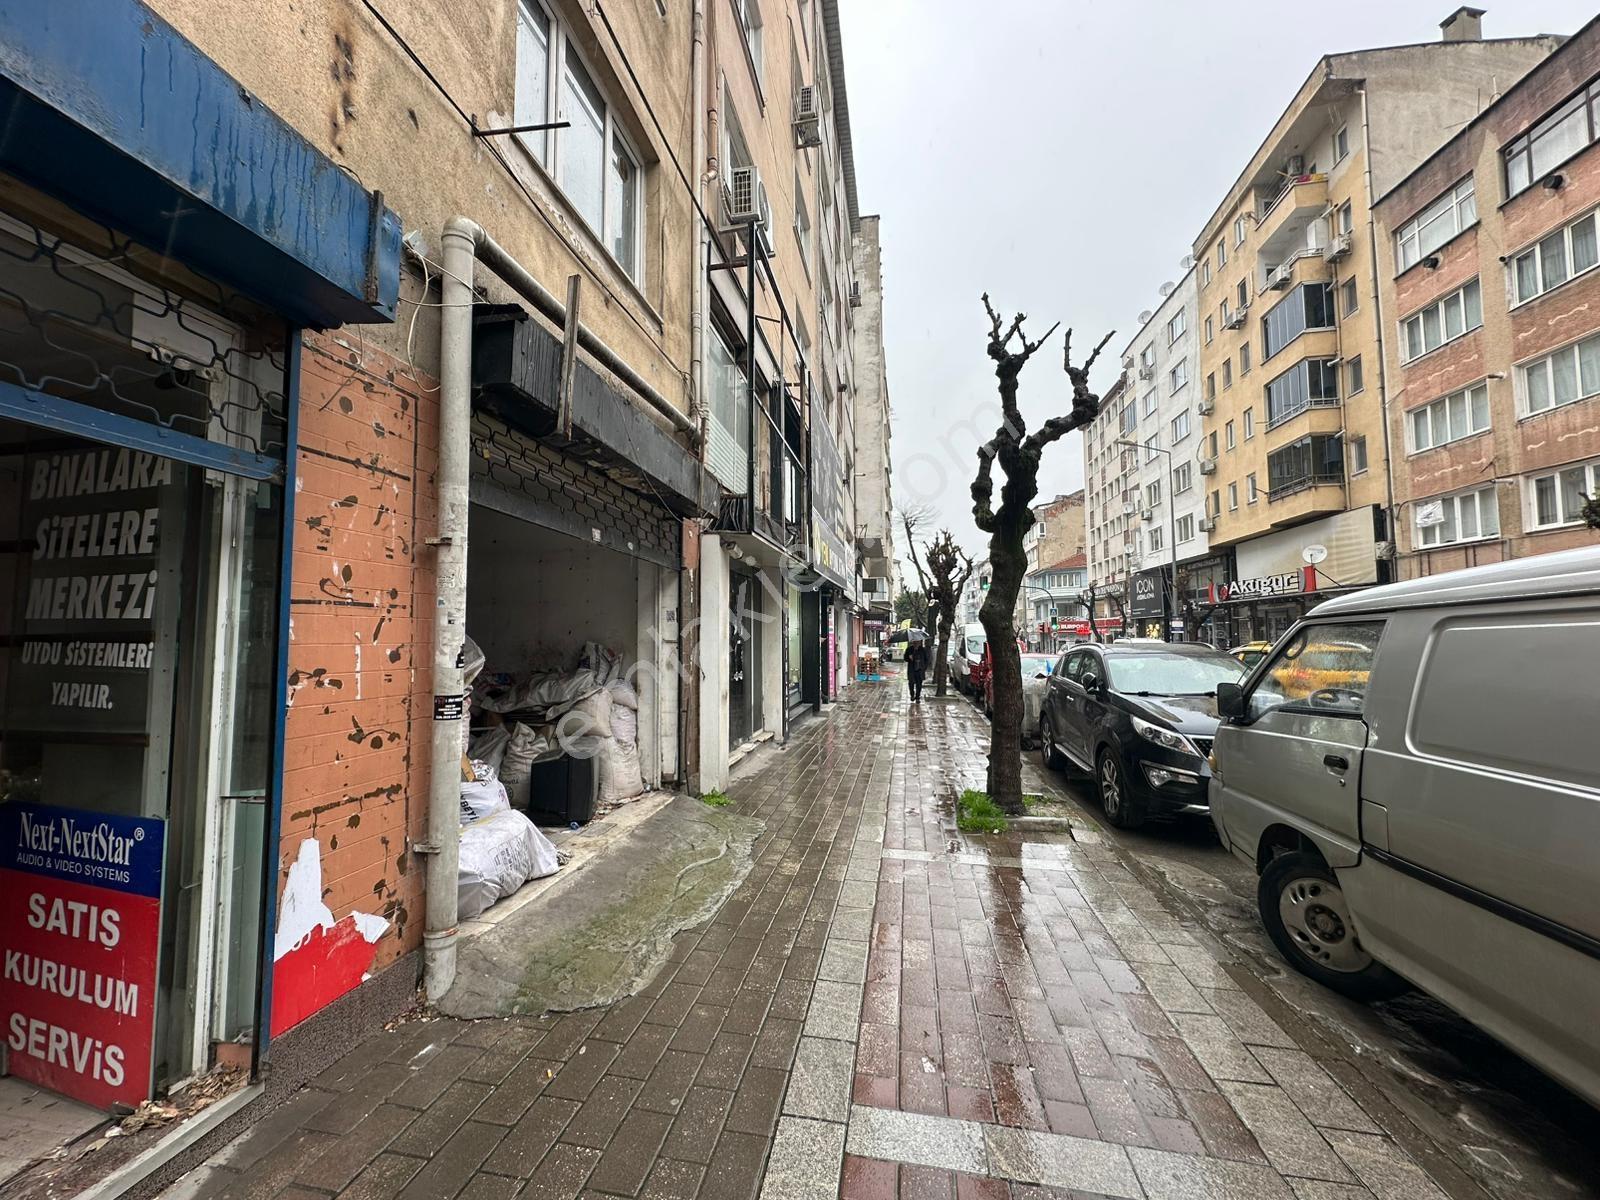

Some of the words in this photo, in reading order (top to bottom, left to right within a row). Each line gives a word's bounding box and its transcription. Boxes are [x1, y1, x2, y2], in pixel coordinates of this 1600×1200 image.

[21, 641, 61, 665] UYDU
[51, 681, 114, 710] YAPILIR.
[16, 852, 44, 867] AUDIO
[45, 857, 52, 868] &
[54, 858, 83, 875] VIDEO
[84, 864, 131, 883] SYSTEMS
[27, 892, 121, 951] SATIŞ
[4, 949, 139, 1018] KURULUM
